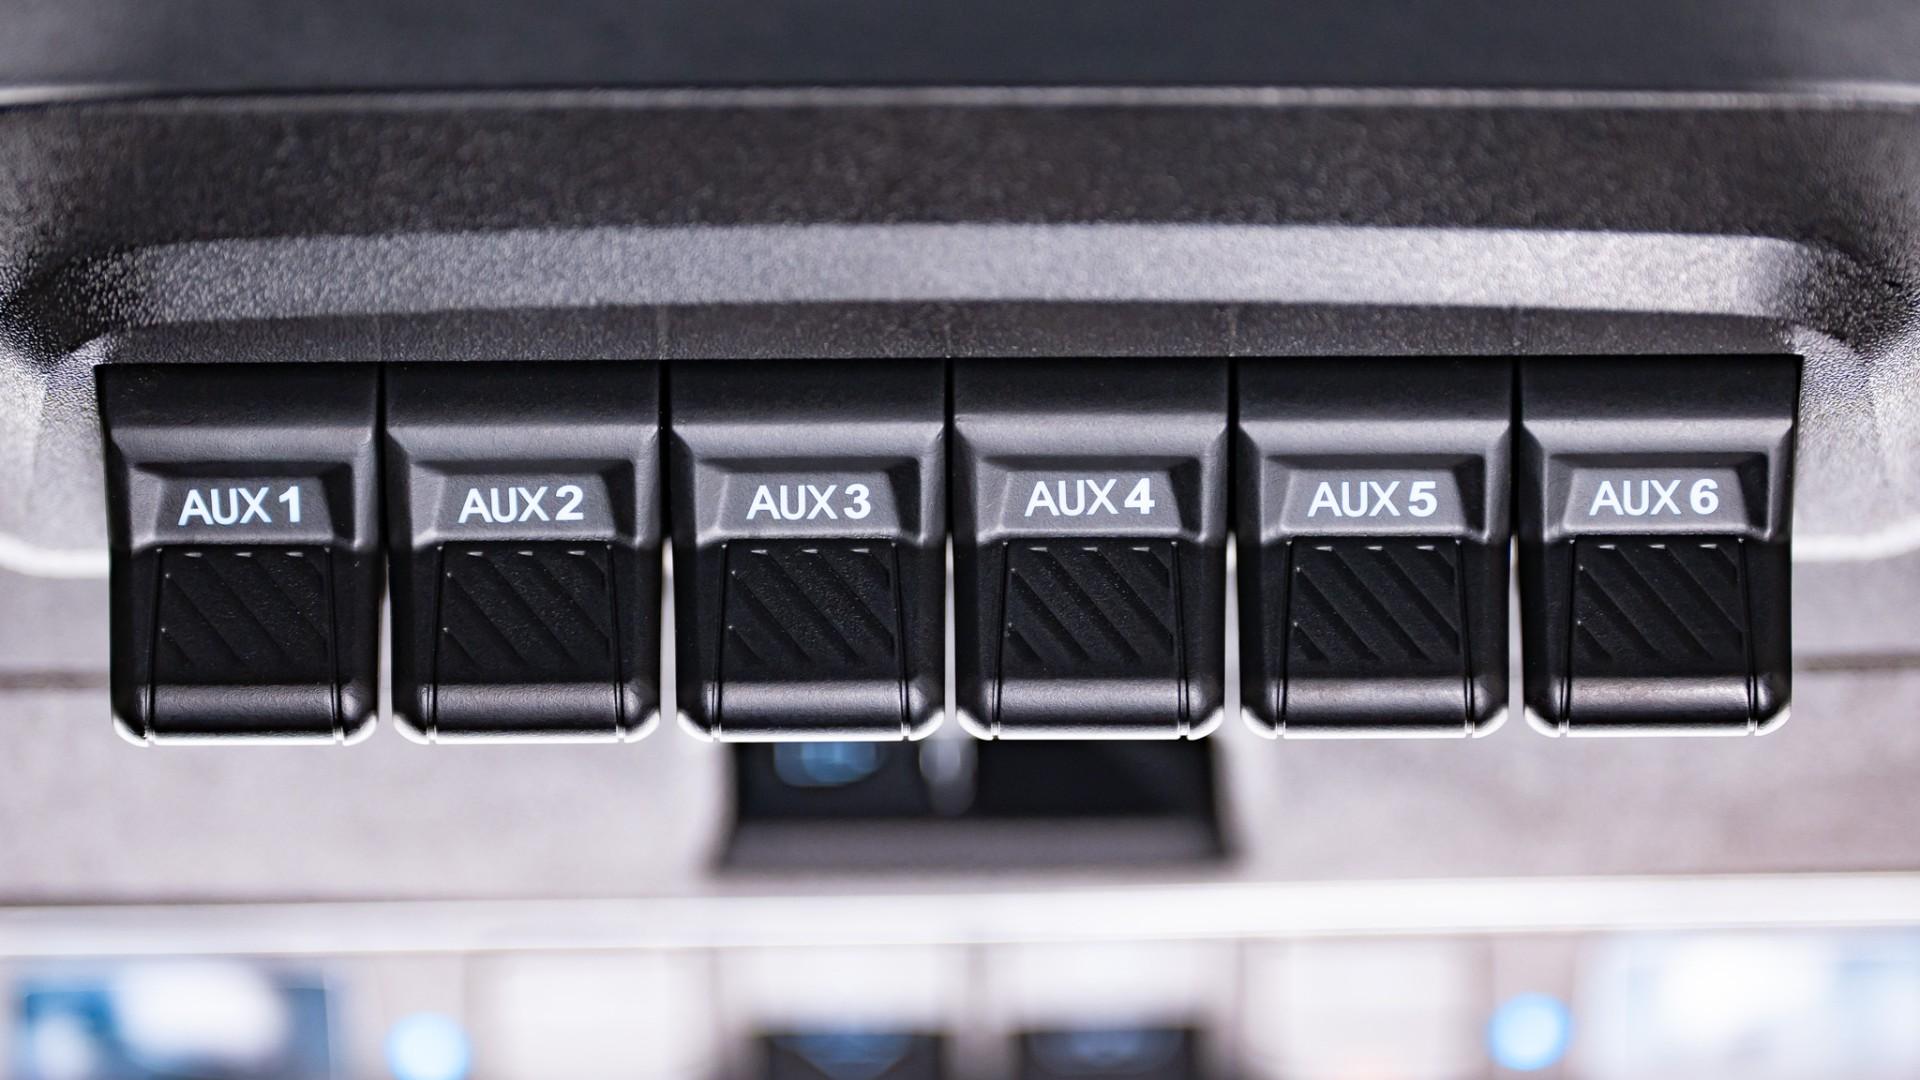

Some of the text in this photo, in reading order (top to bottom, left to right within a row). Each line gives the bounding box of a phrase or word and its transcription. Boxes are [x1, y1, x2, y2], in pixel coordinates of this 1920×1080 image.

[178, 485, 301, 525] AUX 1
[457, 484, 585, 524] AUX 2
[745, 483, 872, 521] AUX 3
[1024, 477, 1155, 517] AUX 4
[1307, 480, 1438, 518] AUX 5
[1588, 478, 1719, 517] AUX 6
